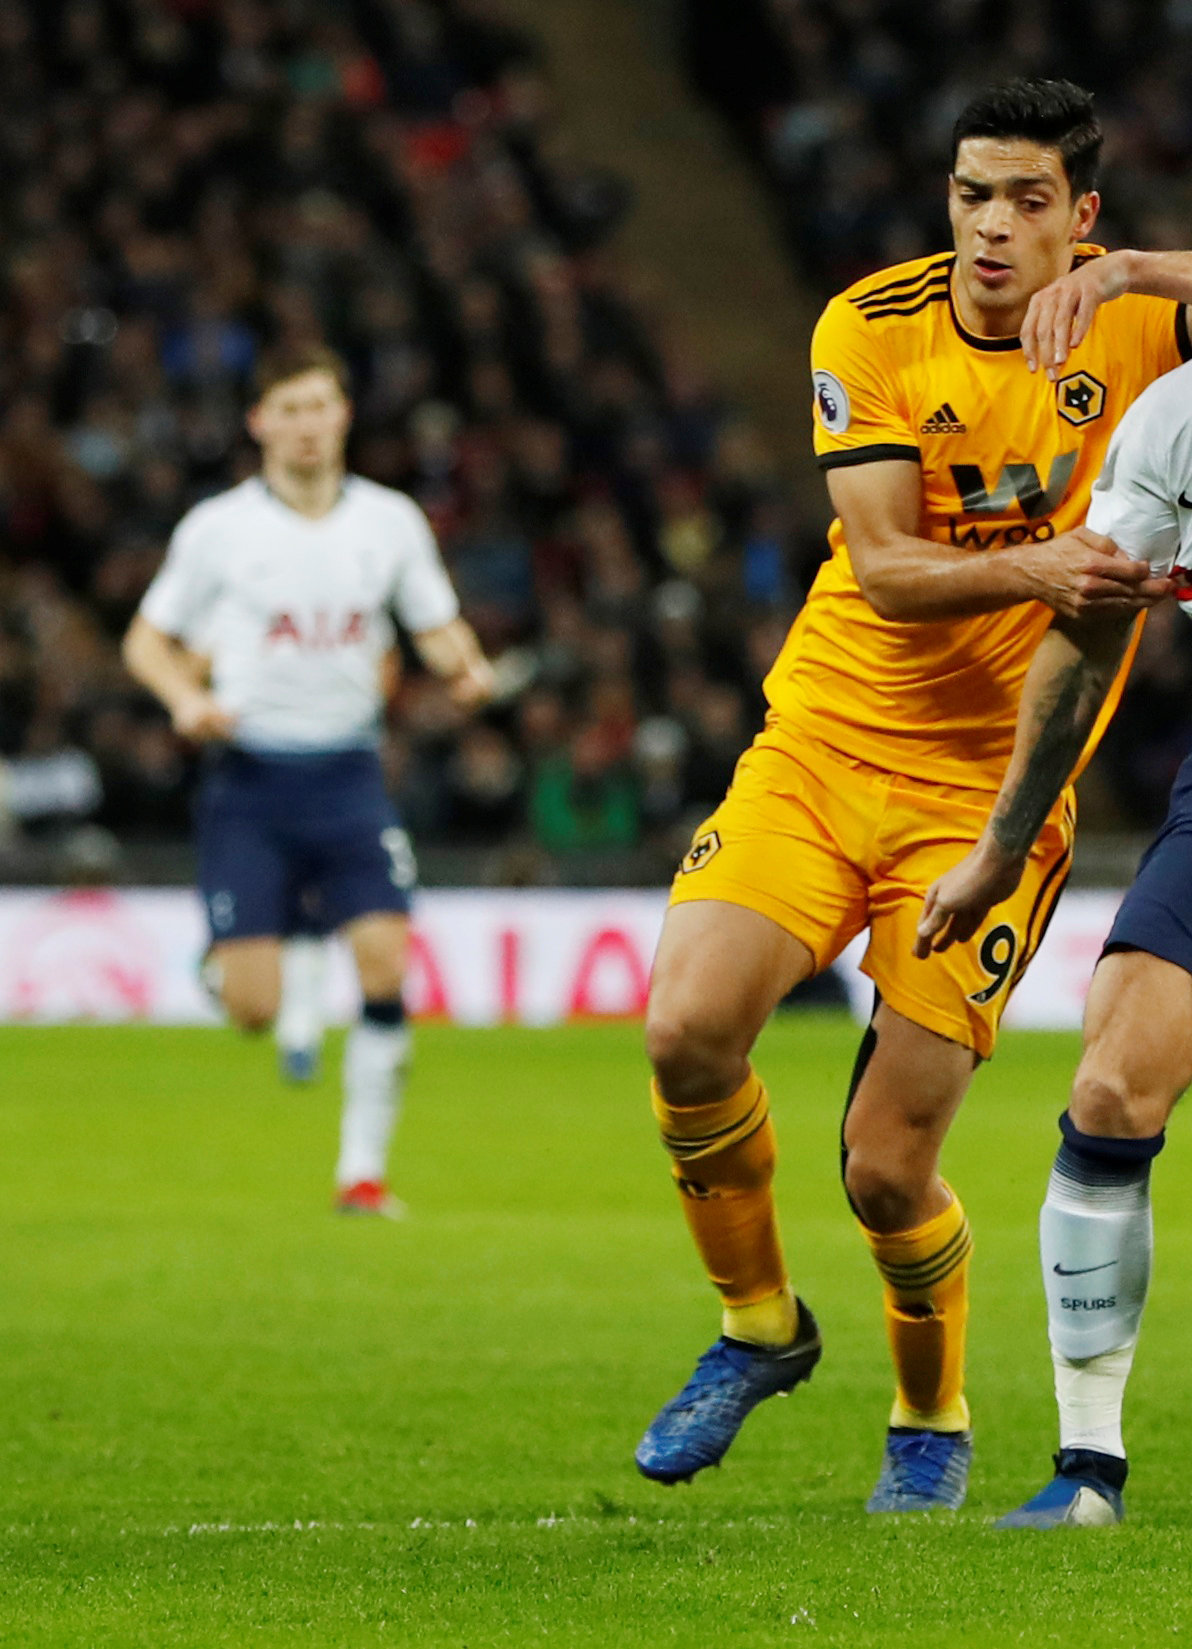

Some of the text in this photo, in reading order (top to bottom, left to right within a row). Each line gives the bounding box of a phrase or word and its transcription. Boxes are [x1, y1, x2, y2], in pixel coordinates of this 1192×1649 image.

[920, 423, 967, 434] adidas
[967, 924, 1016, 1004] 9
[1061, 1296, 1116, 1311] SPURS
